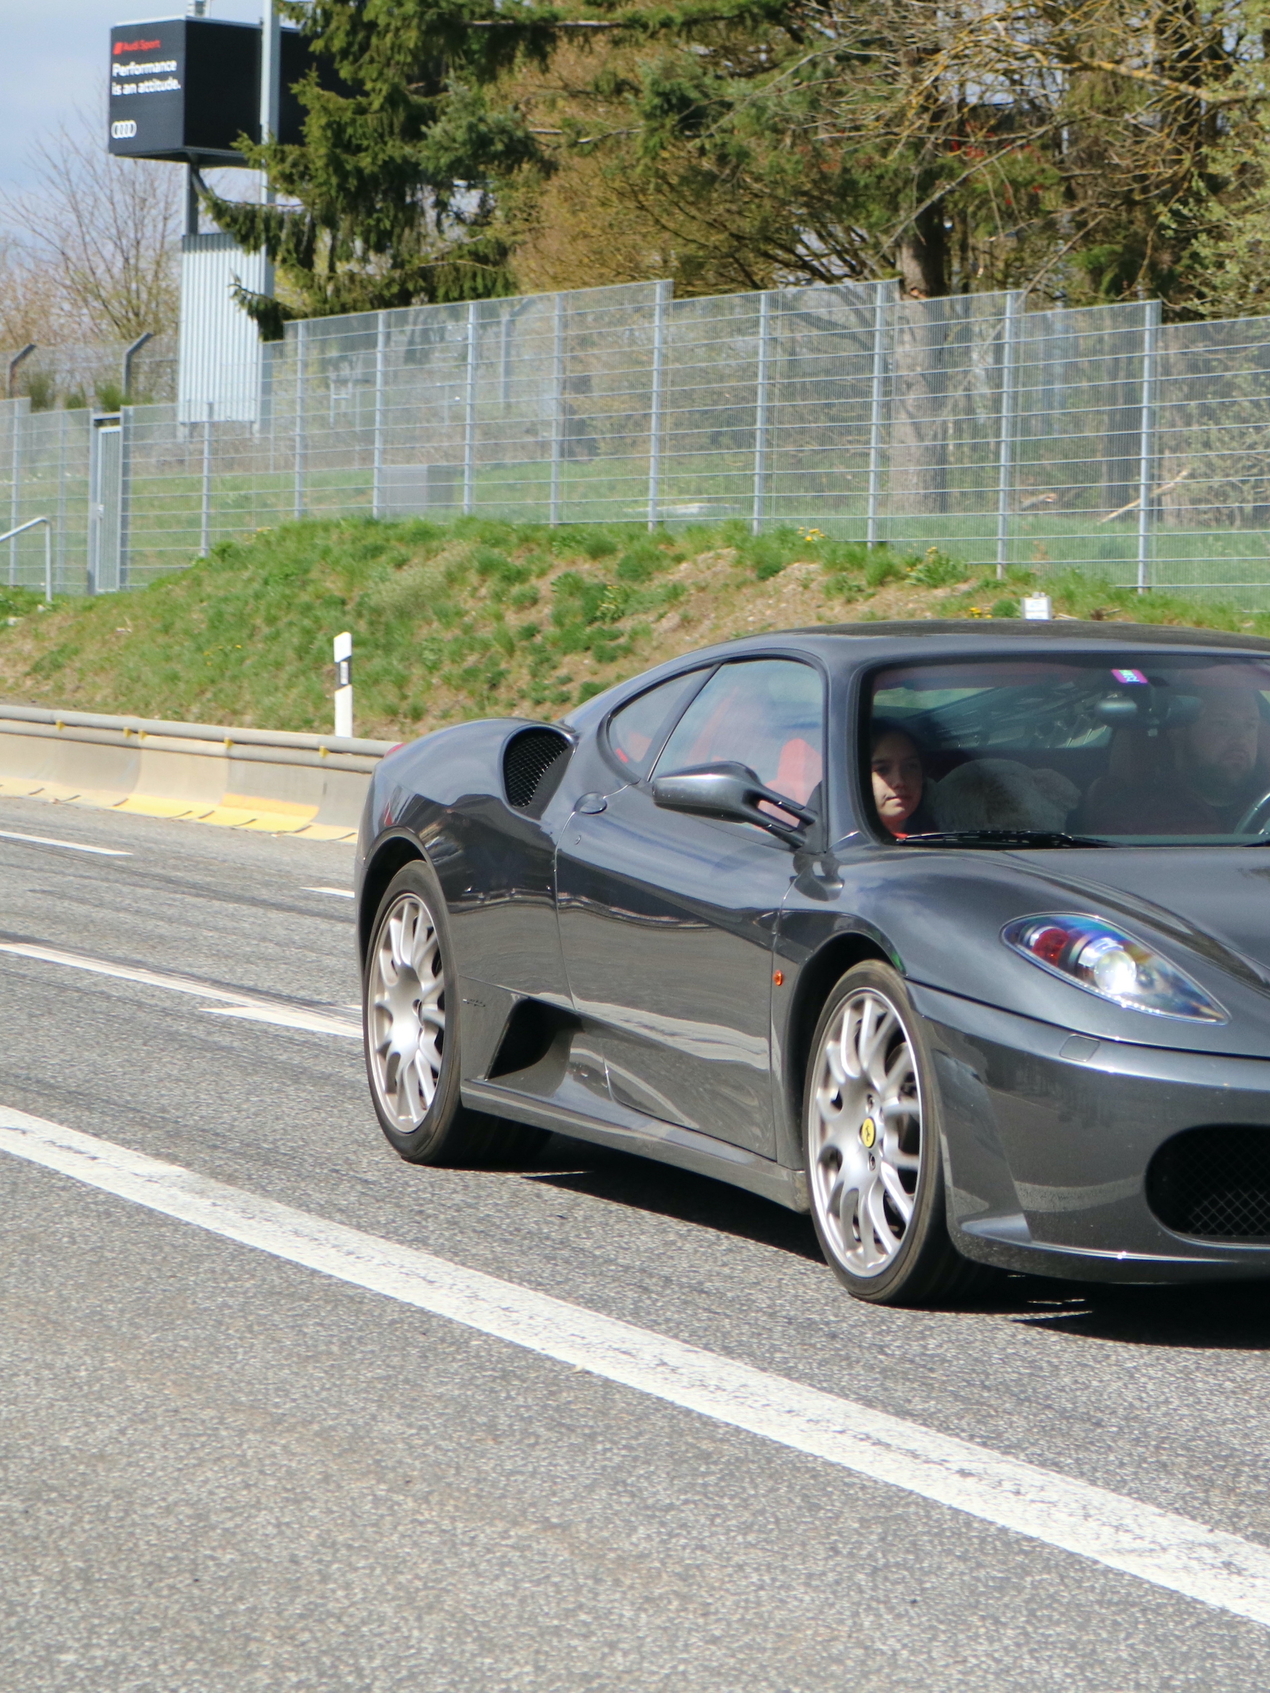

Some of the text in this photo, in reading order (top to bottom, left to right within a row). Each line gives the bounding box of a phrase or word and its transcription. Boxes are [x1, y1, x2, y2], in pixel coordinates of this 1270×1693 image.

[112, 60, 177, 77] Performance
[112, 76, 181, 95] is an attitude.
